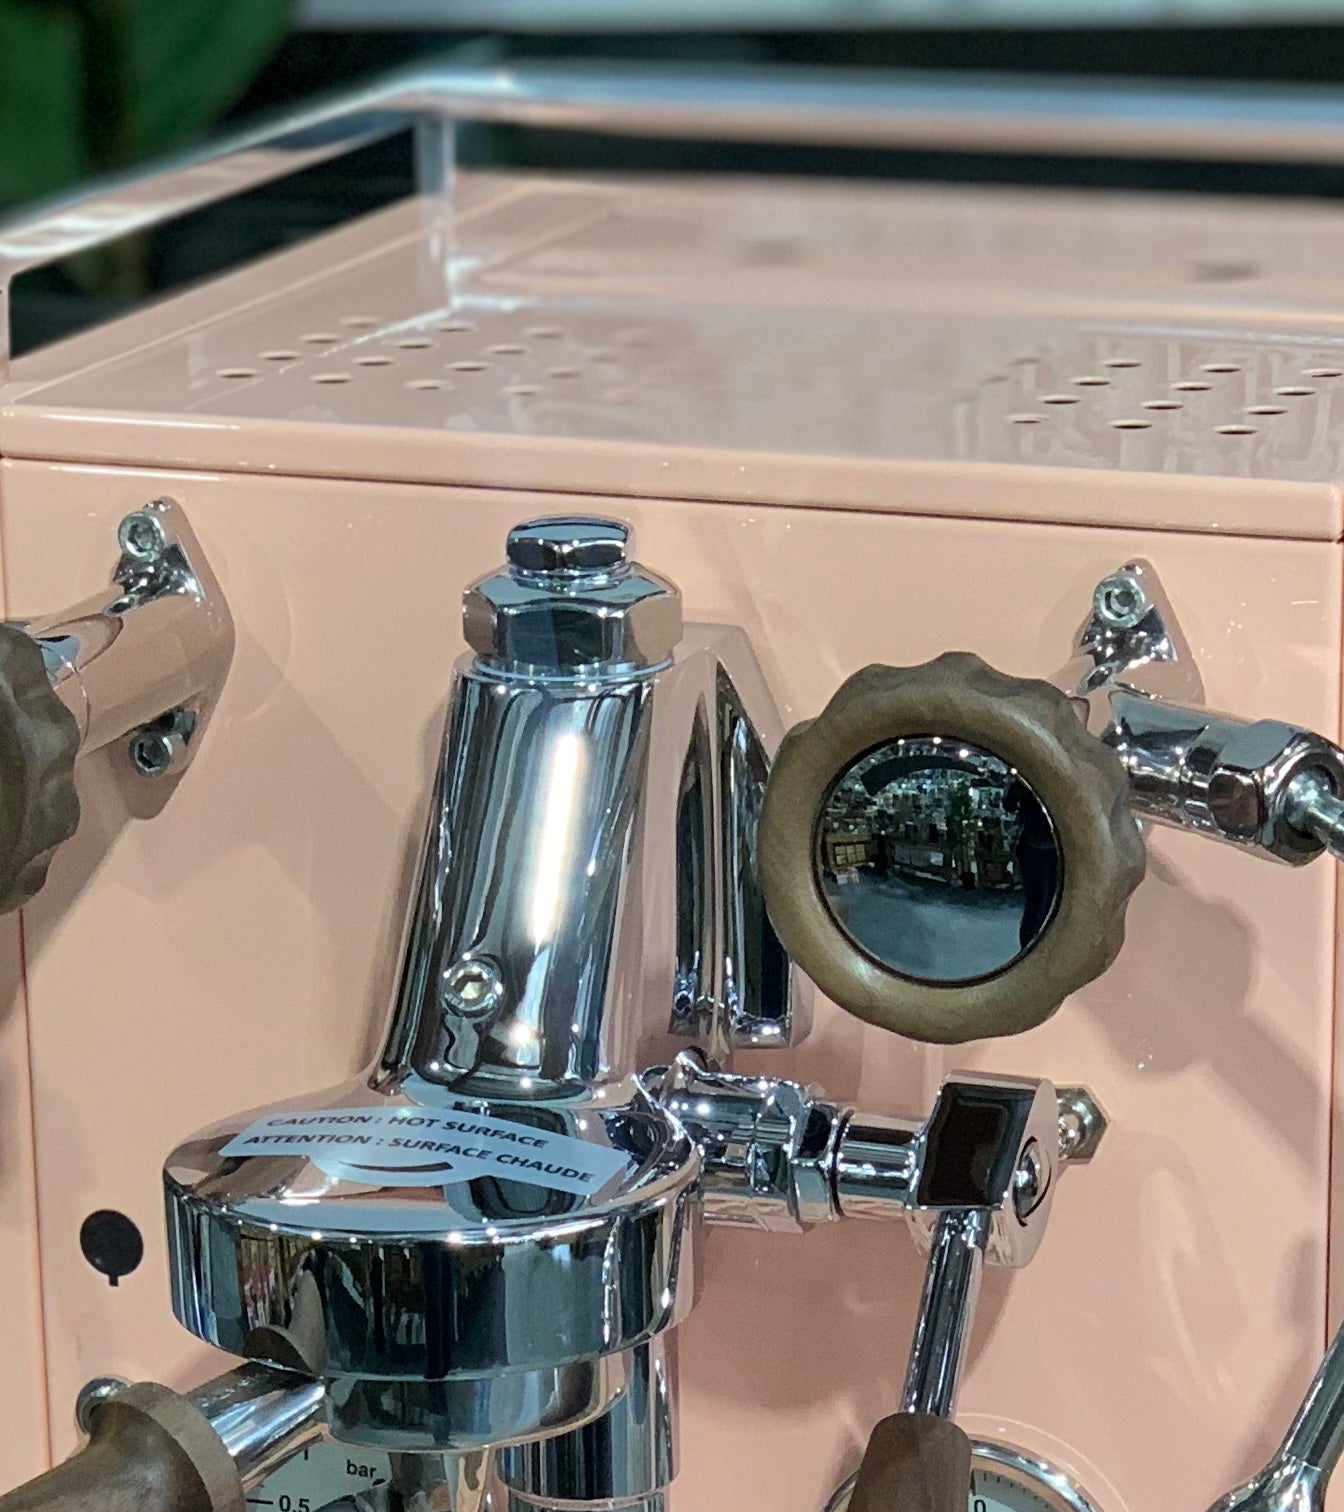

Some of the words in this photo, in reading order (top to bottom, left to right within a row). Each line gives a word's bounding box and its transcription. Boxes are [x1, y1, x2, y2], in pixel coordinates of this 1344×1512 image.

[267, 1115, 373, 1127] CAUTION
[389, 1115, 441, 1128] HOT
[442, 1121, 549, 1149] SURFACE
[243, 1134, 373, 1145] ATTENTION
[389, 1137, 492, 1161] SURFACE
[495, 1153, 595, 1184] CHAUDE
[346, 1459, 377, 1479] bar
